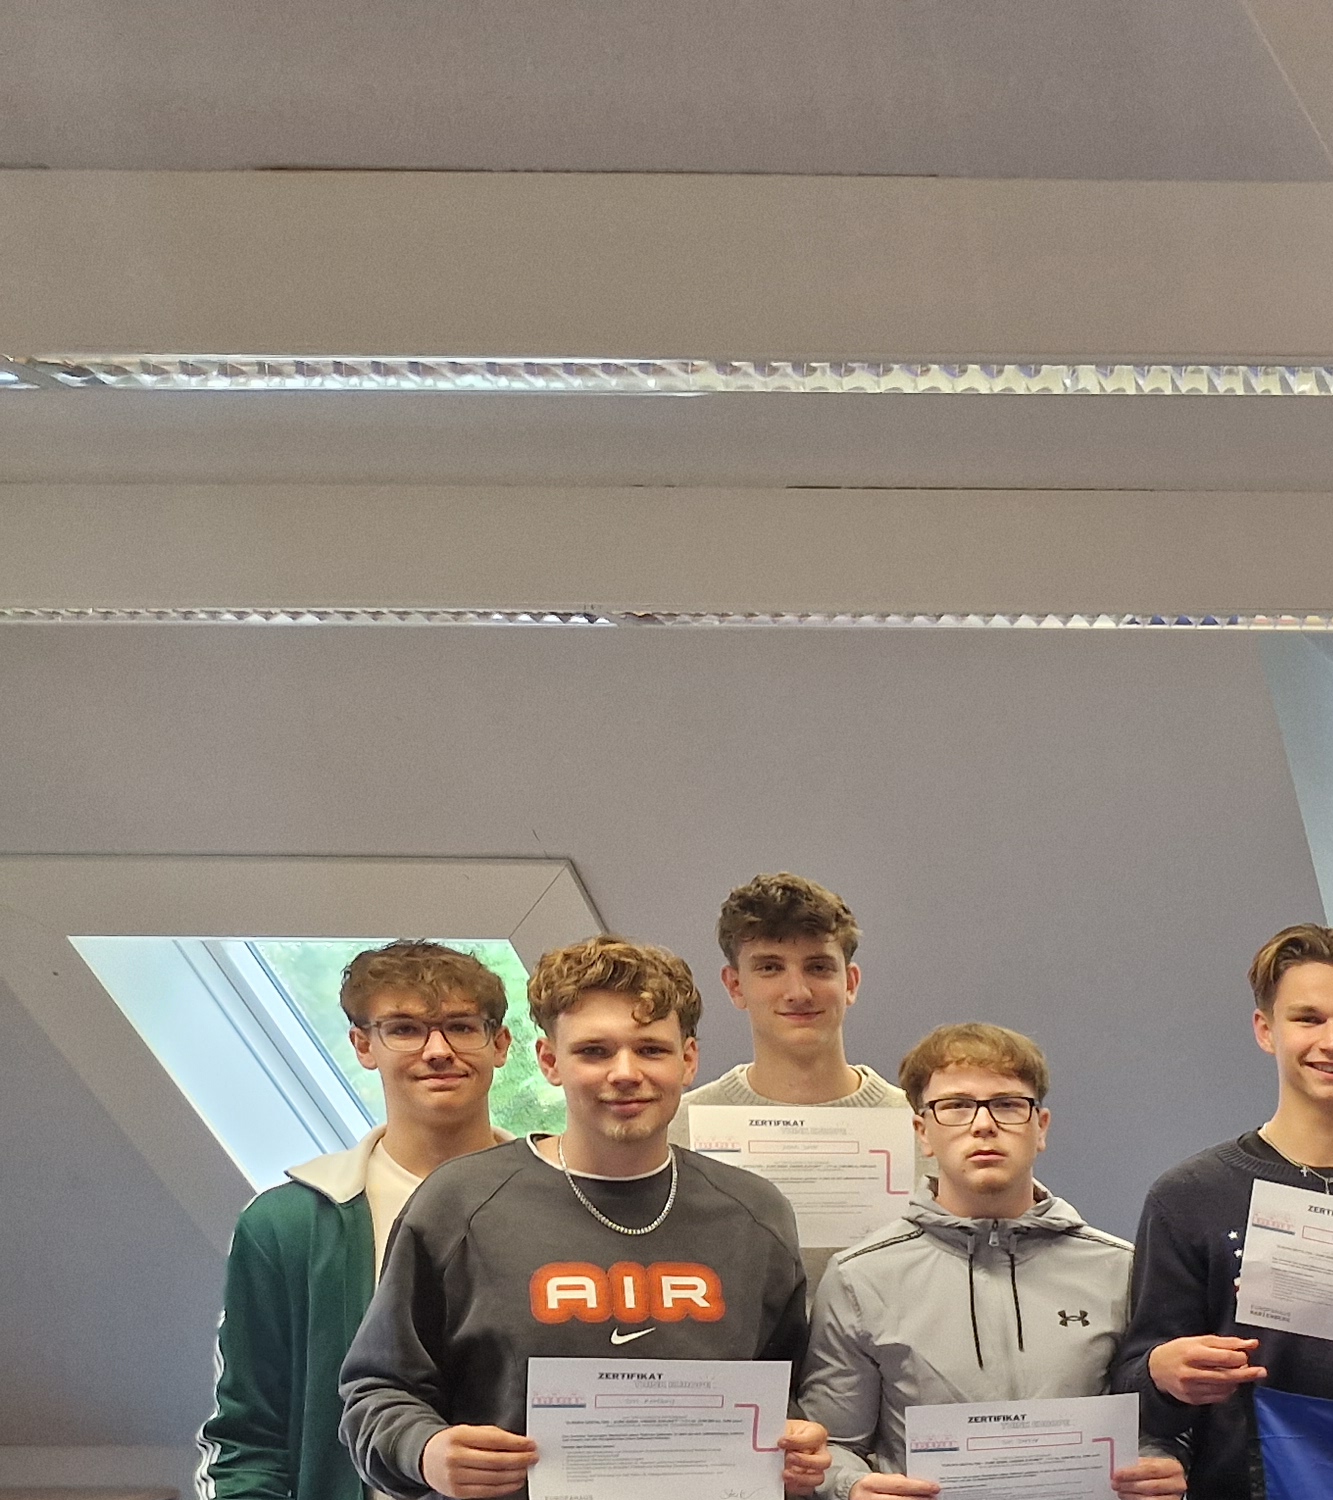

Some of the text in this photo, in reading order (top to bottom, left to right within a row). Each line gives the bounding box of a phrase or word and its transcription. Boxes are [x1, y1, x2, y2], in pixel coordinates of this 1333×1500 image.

[544, 1273, 712, 1311] AIR
[598, 1372, 663, 1380] ZERTIFIKAT
[967, 1414, 1027, 1424] ZERTIFIKAT
